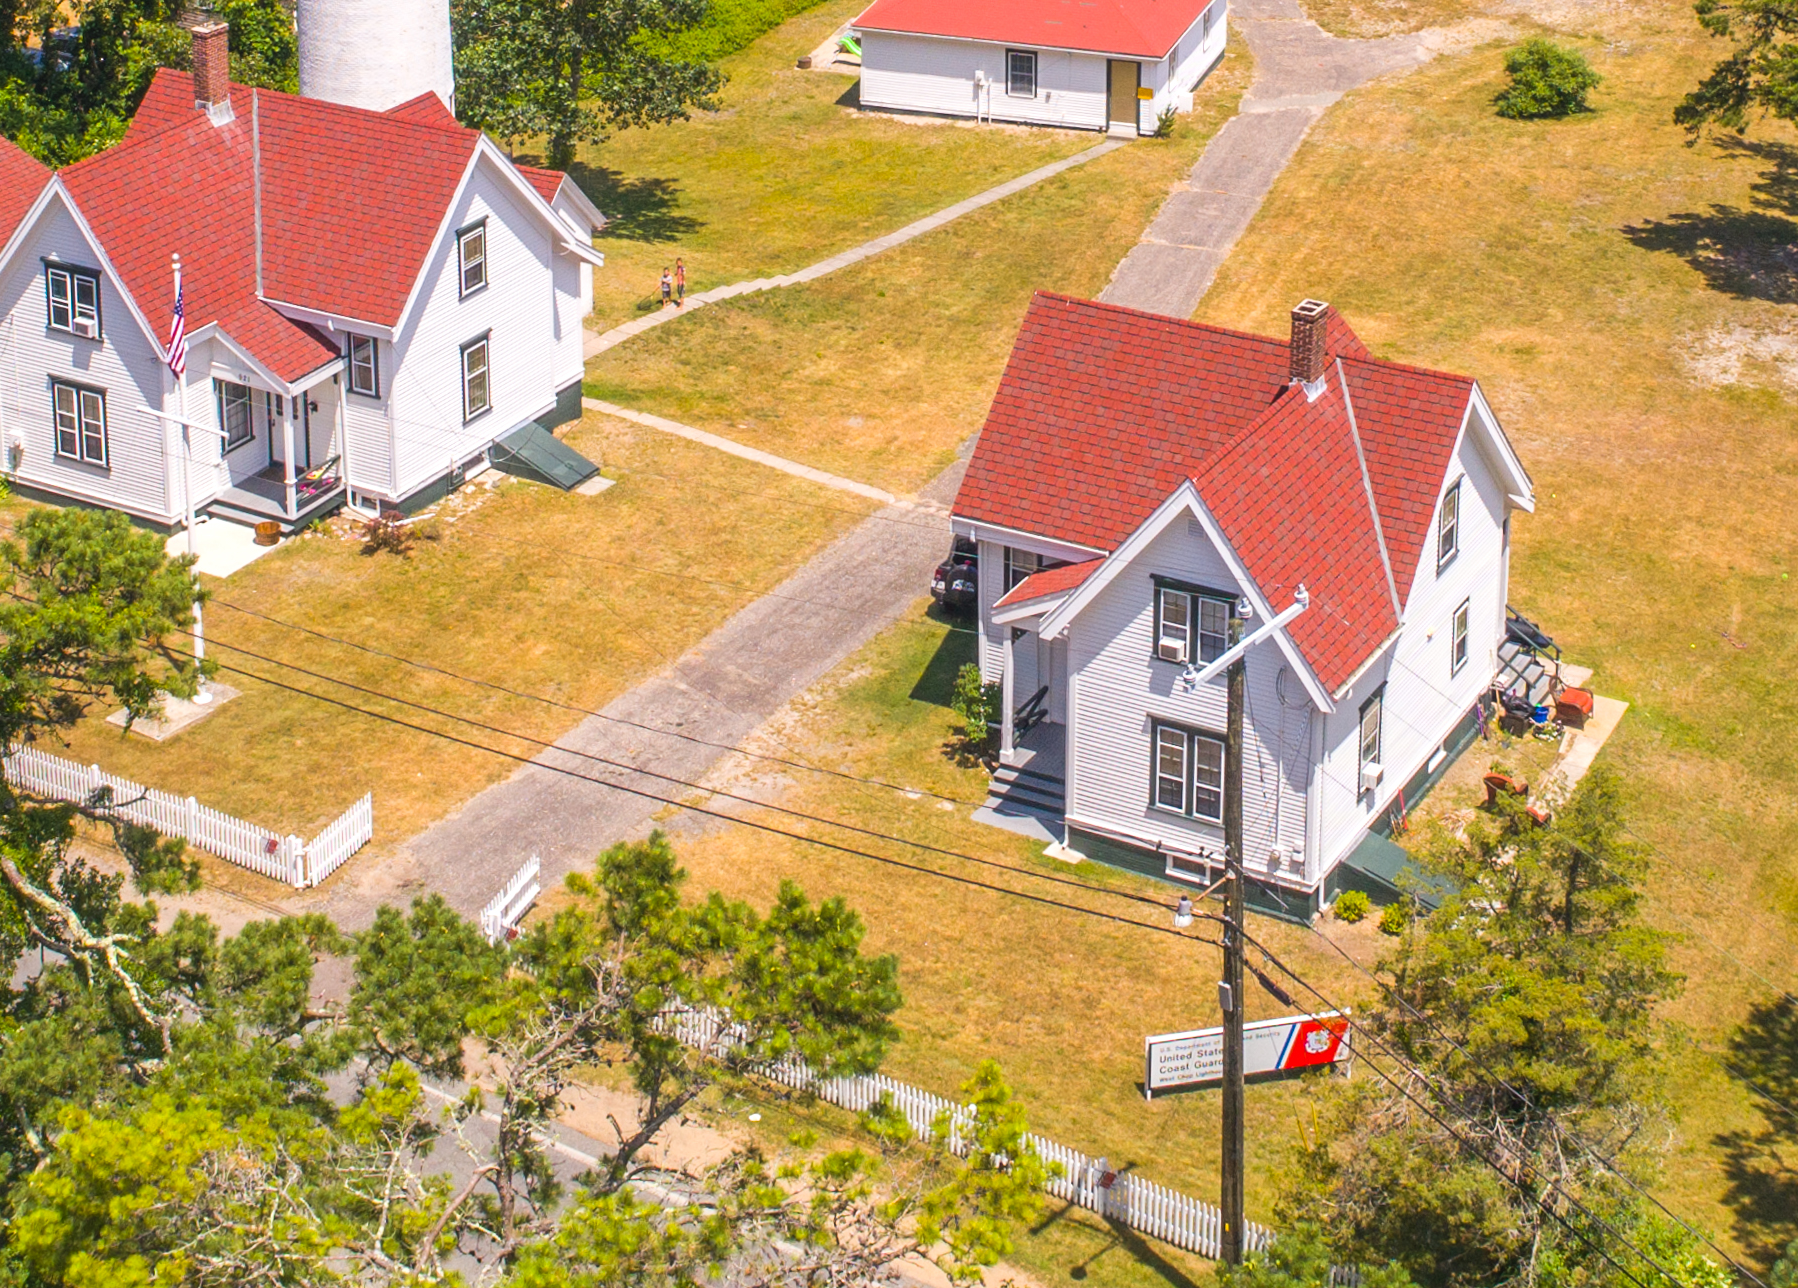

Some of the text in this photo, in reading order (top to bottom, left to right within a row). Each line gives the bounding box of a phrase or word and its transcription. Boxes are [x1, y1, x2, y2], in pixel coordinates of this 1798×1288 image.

[1159, 1048, 1223, 1064] United State
[1159, 1062, 1190, 1074] Coast
